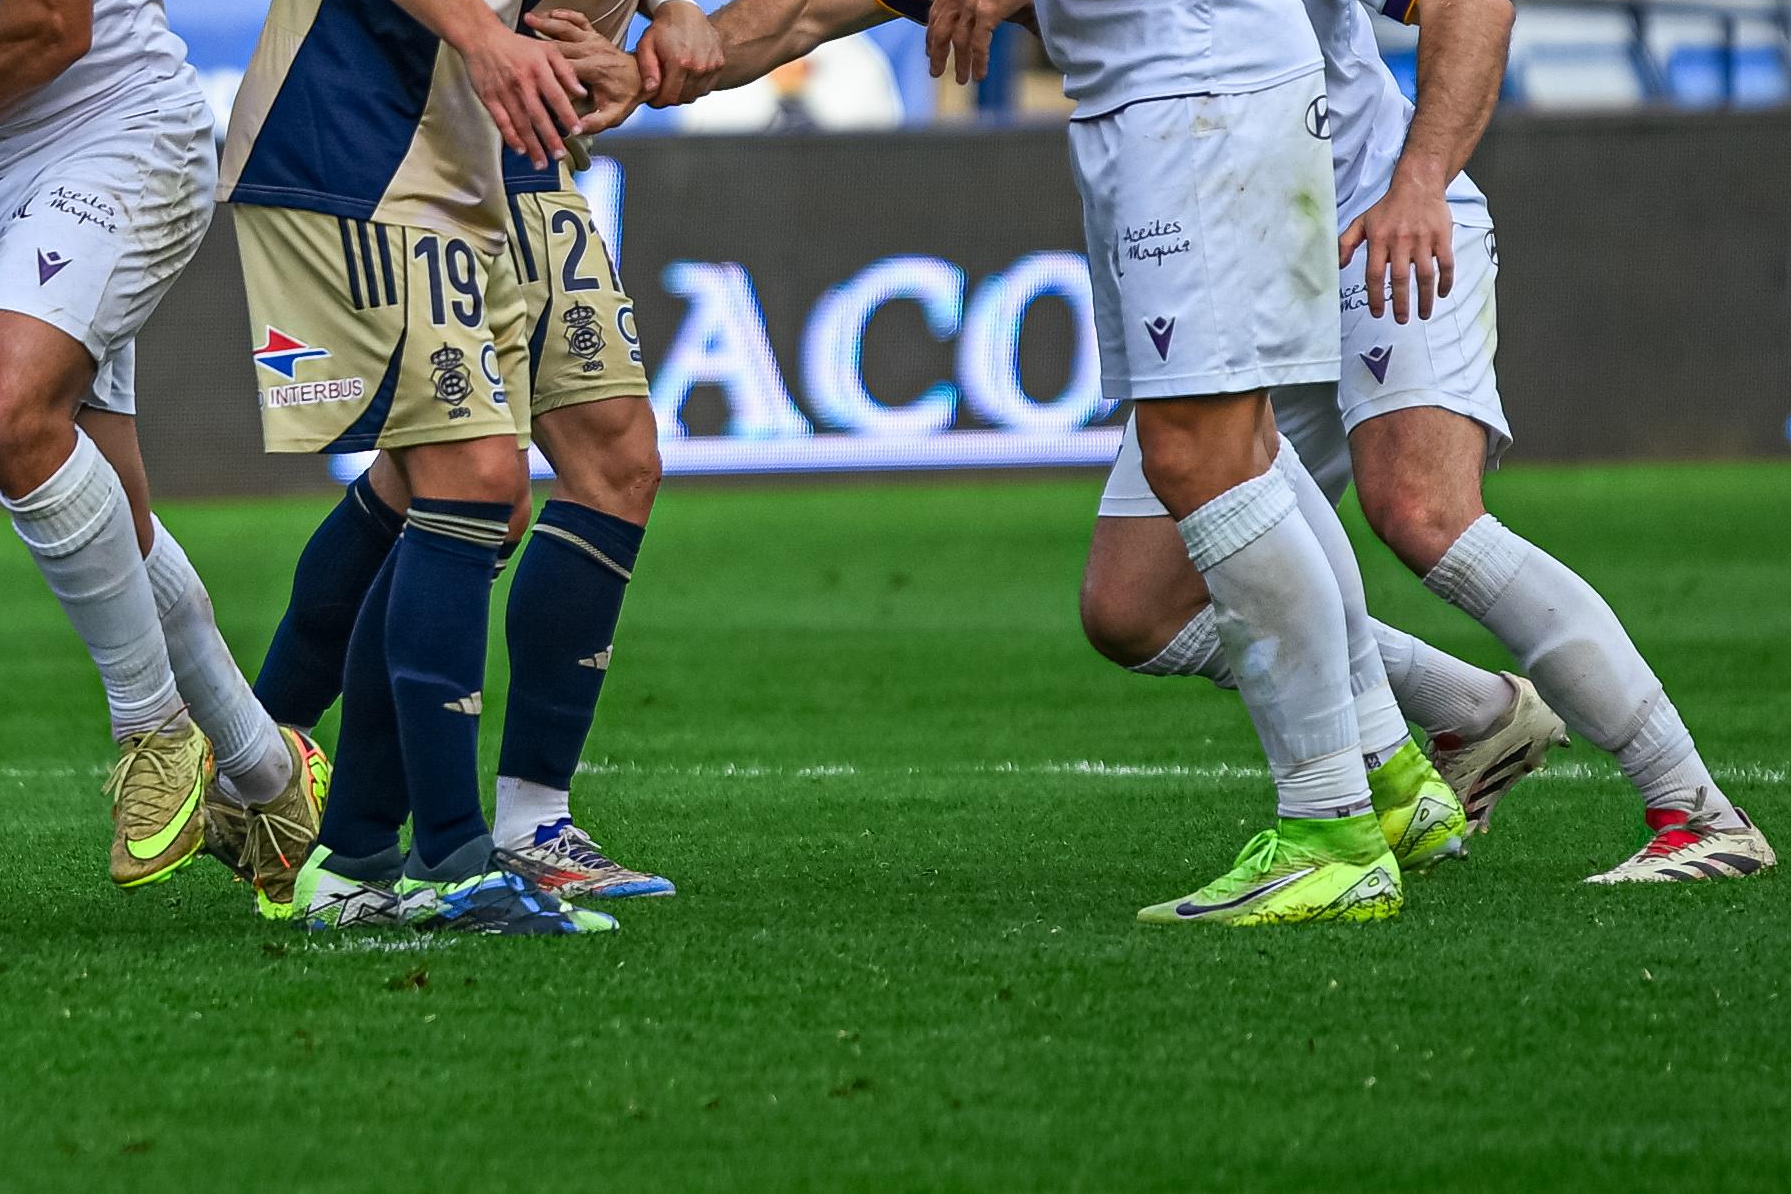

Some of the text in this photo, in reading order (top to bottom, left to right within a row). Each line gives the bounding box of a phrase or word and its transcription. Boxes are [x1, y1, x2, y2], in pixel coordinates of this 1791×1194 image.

[50, 186, 115, 217] Aceites
[1124, 219, 1182, 243] Aceites
[414, 236, 482, 329] 19
[270, 380, 363, 406] INTERBUS
